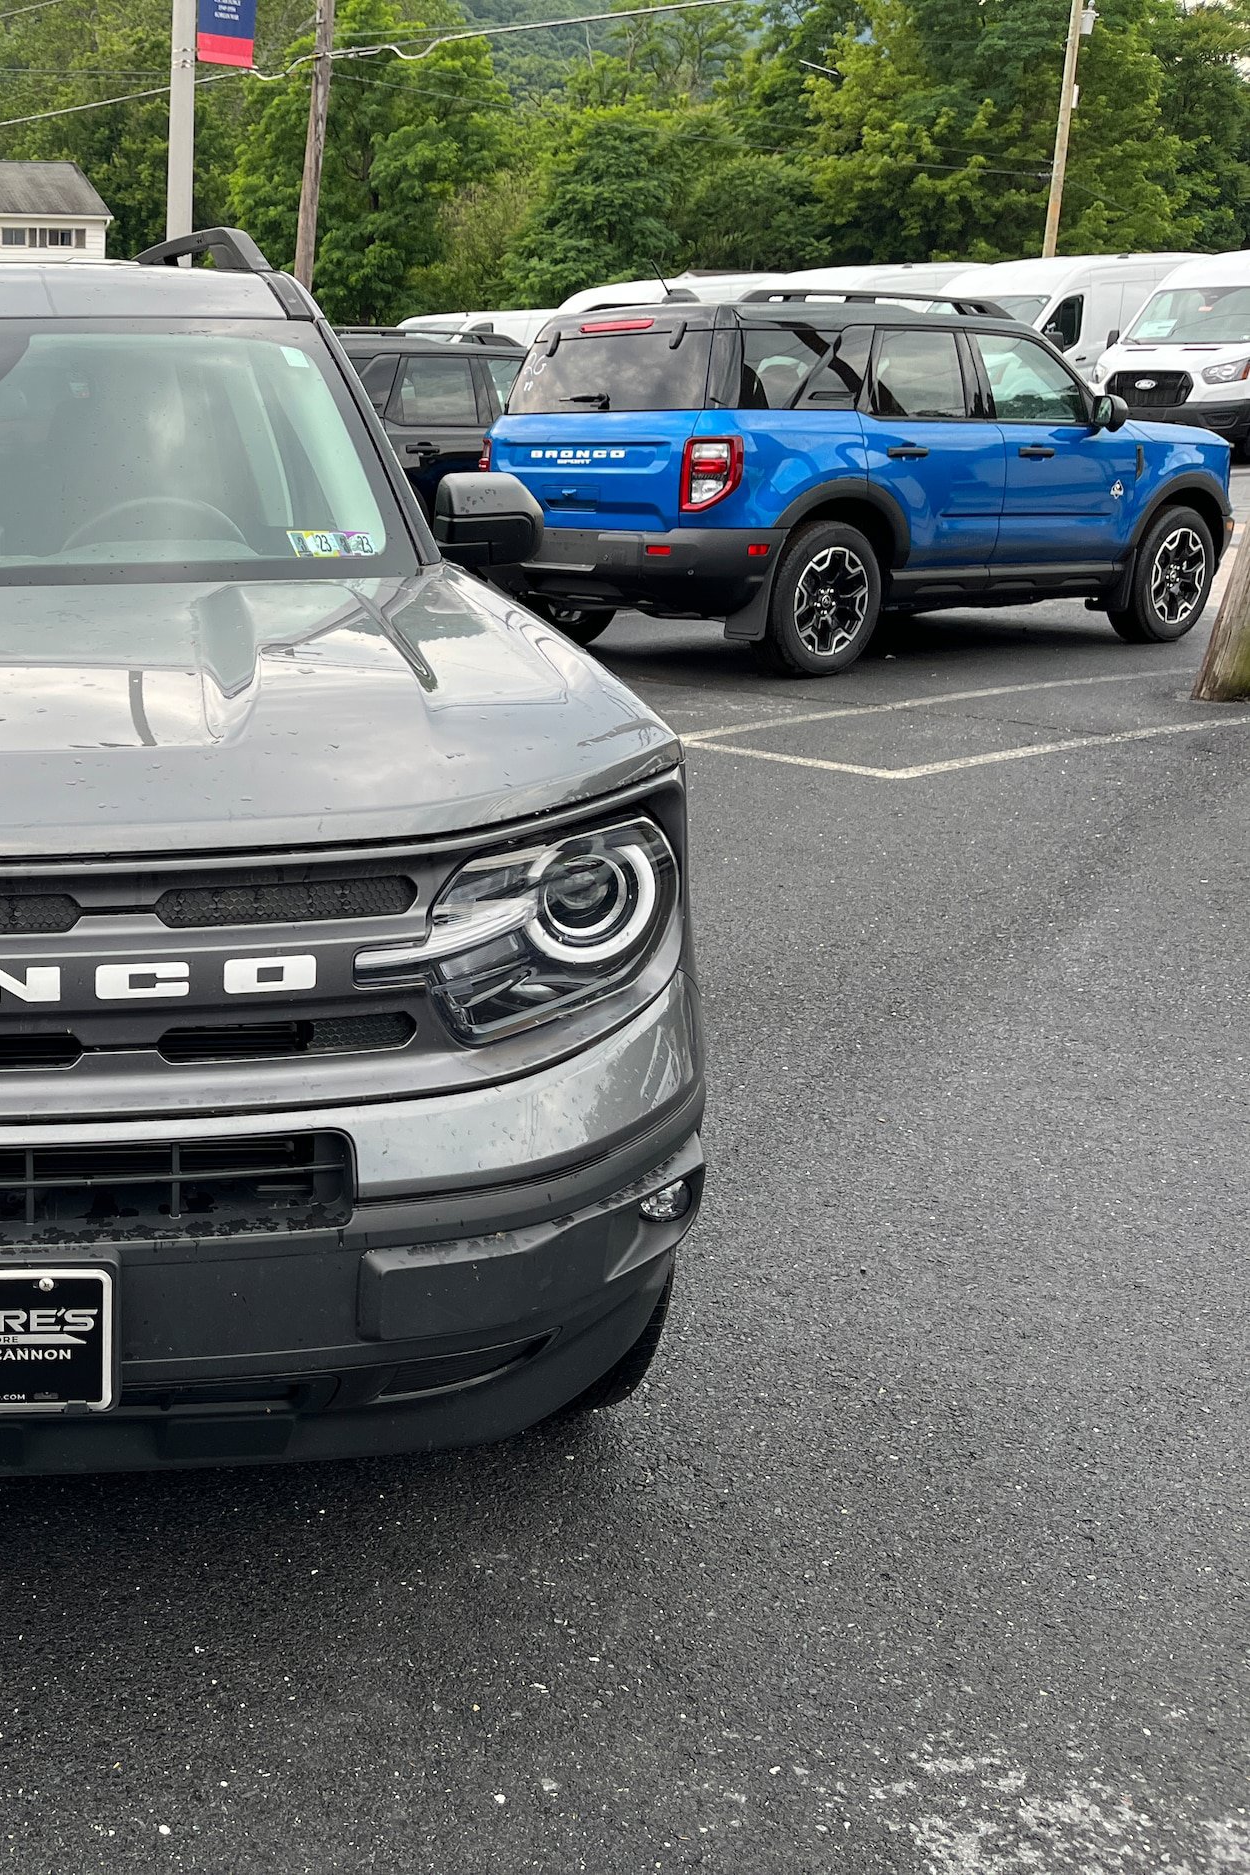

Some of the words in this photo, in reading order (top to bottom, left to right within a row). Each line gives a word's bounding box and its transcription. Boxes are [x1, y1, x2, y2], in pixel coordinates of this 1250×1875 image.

[531, 450, 625, 458] BRONCO
[315, 534, 332, 552] 23
[357, 536, 373, 553] 23
